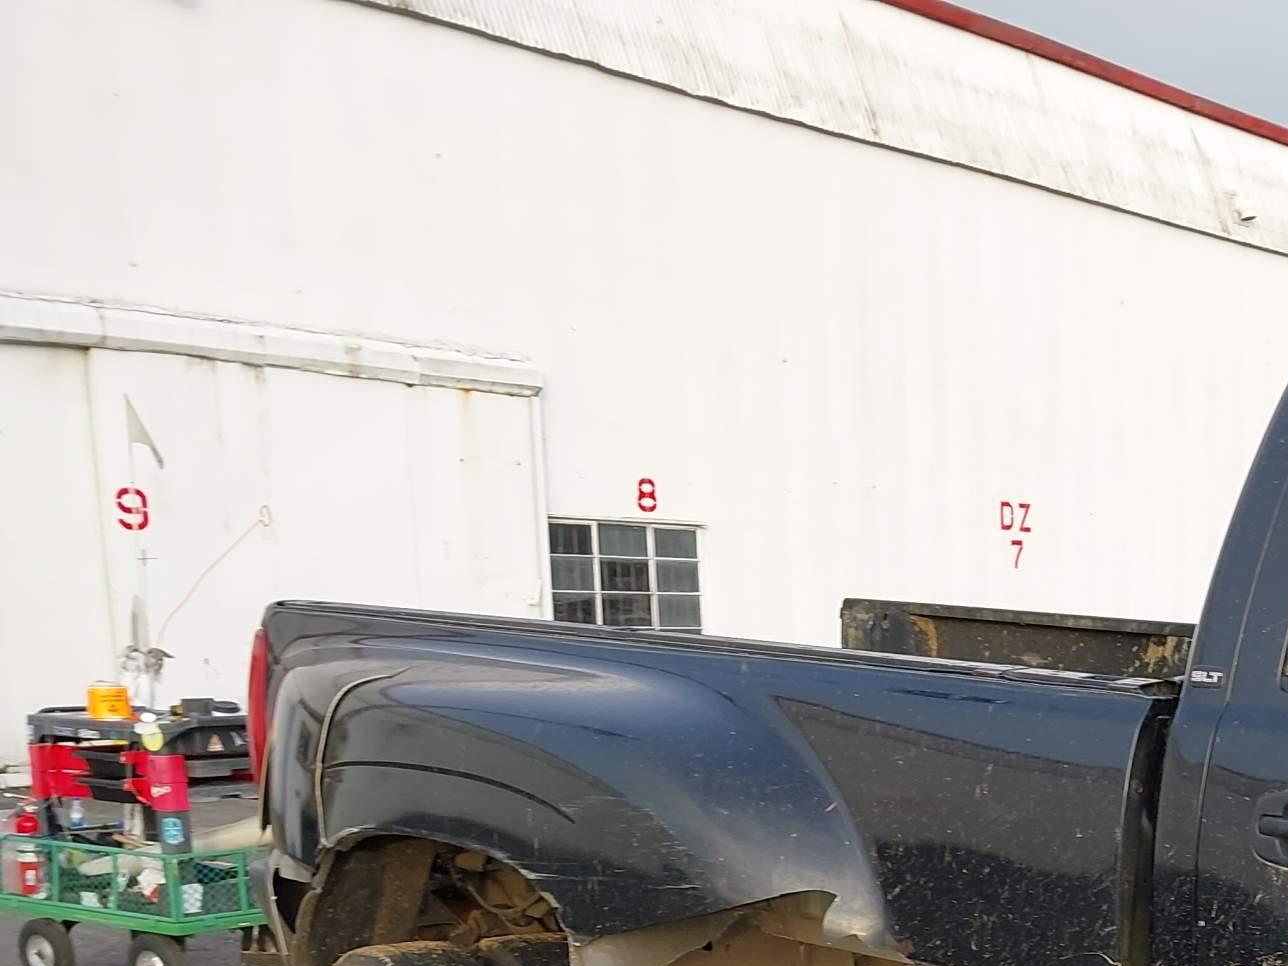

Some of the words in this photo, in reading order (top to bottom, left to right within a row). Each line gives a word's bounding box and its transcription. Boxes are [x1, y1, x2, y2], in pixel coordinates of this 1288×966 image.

[115, 486, 150, 531] 9
[636, 478, 657, 512] 8
[1011, 539, 1023, 569] 7
[1191, 671, 1223, 683] SLT
